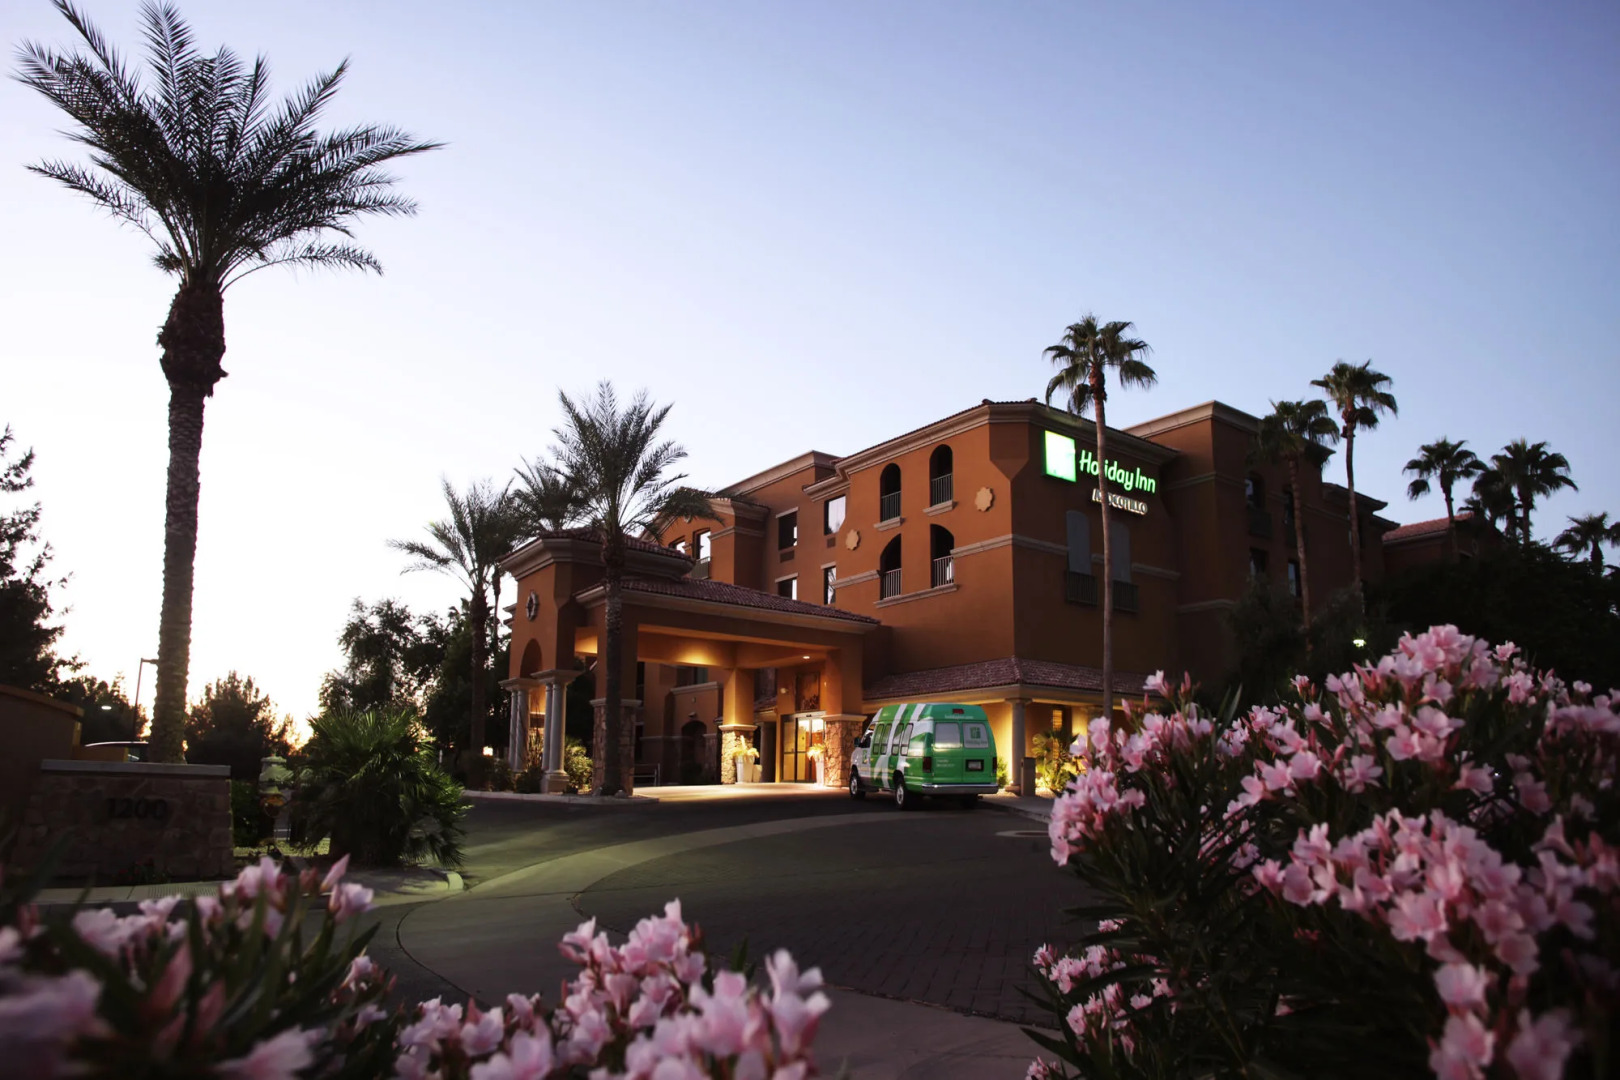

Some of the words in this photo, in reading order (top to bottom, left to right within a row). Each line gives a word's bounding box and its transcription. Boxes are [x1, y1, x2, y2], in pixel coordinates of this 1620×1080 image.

[1079, 450, 1134, 491] Hoiday
[1135, 467, 1156, 493] Inn
[108, 797, 167, 819] 1200
